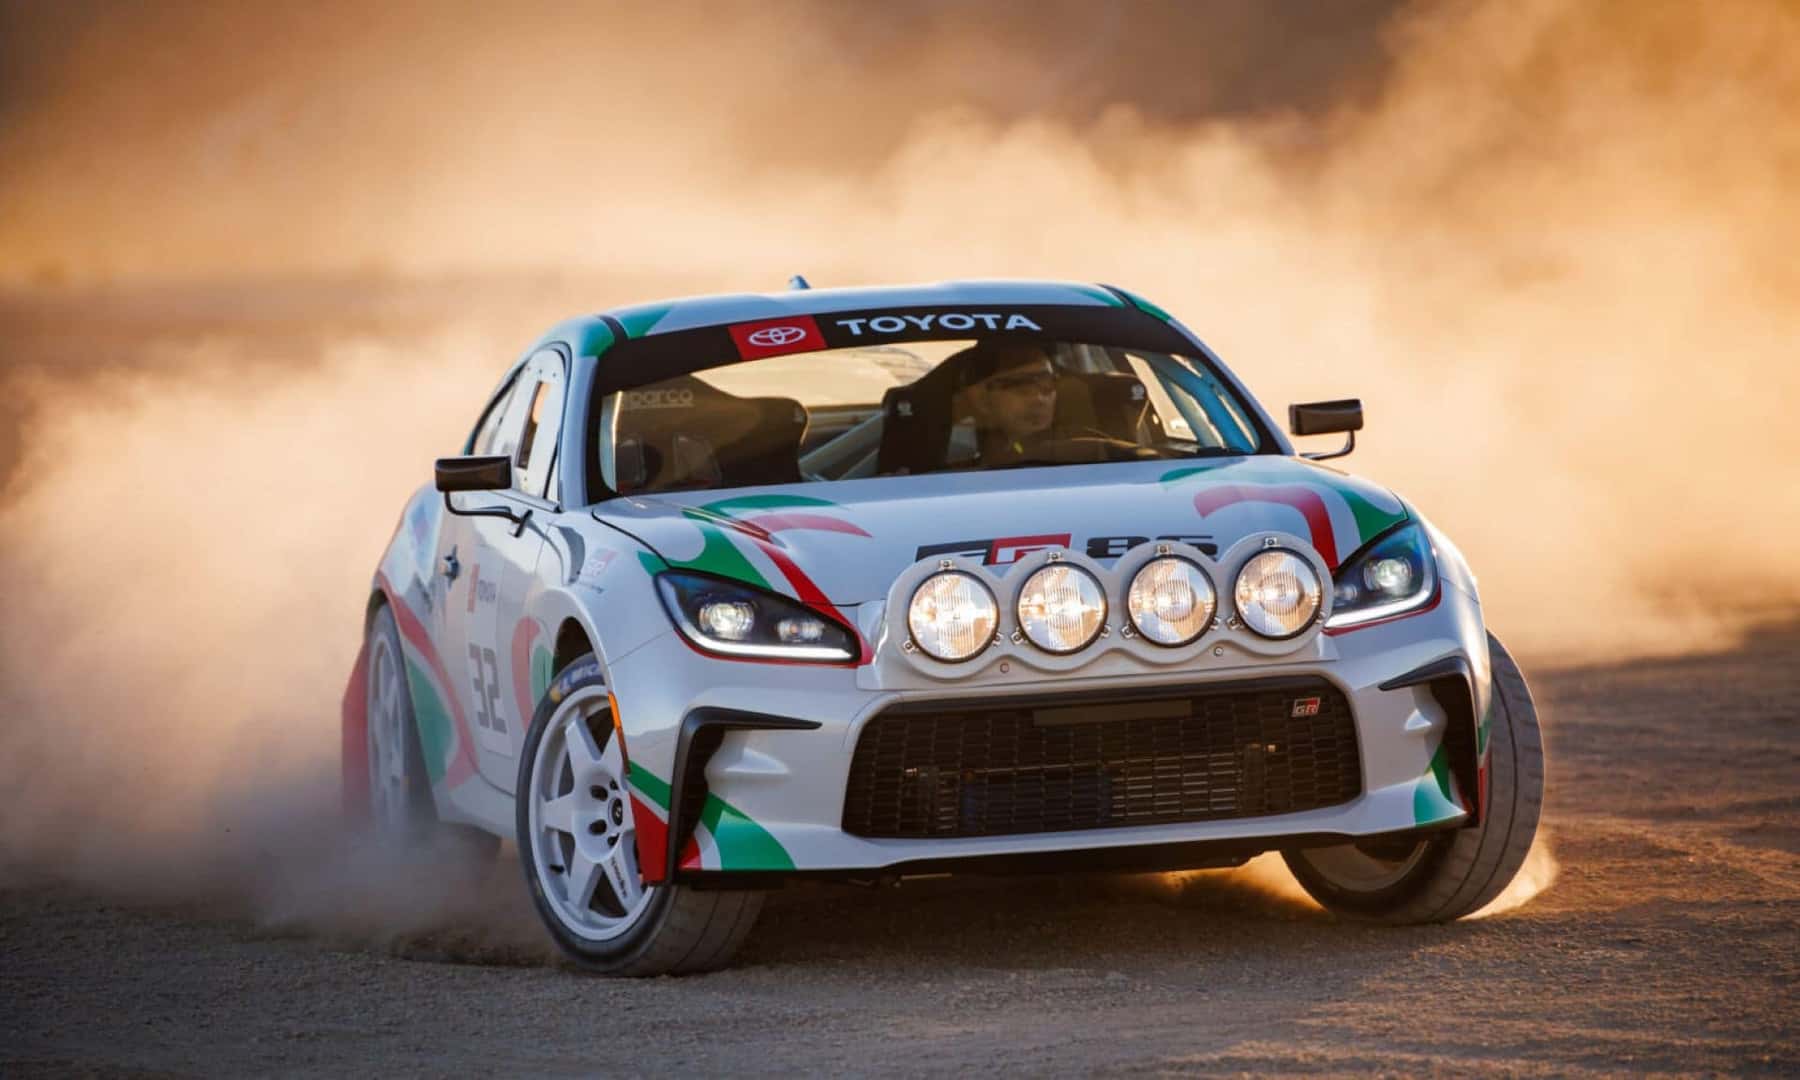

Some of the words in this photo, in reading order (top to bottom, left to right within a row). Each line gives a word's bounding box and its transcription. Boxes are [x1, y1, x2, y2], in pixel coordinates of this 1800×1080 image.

[836, 313, 1043, 336] TOYOTA
[469, 642, 508, 734] 32
[1293, 700, 1319, 717] GR
